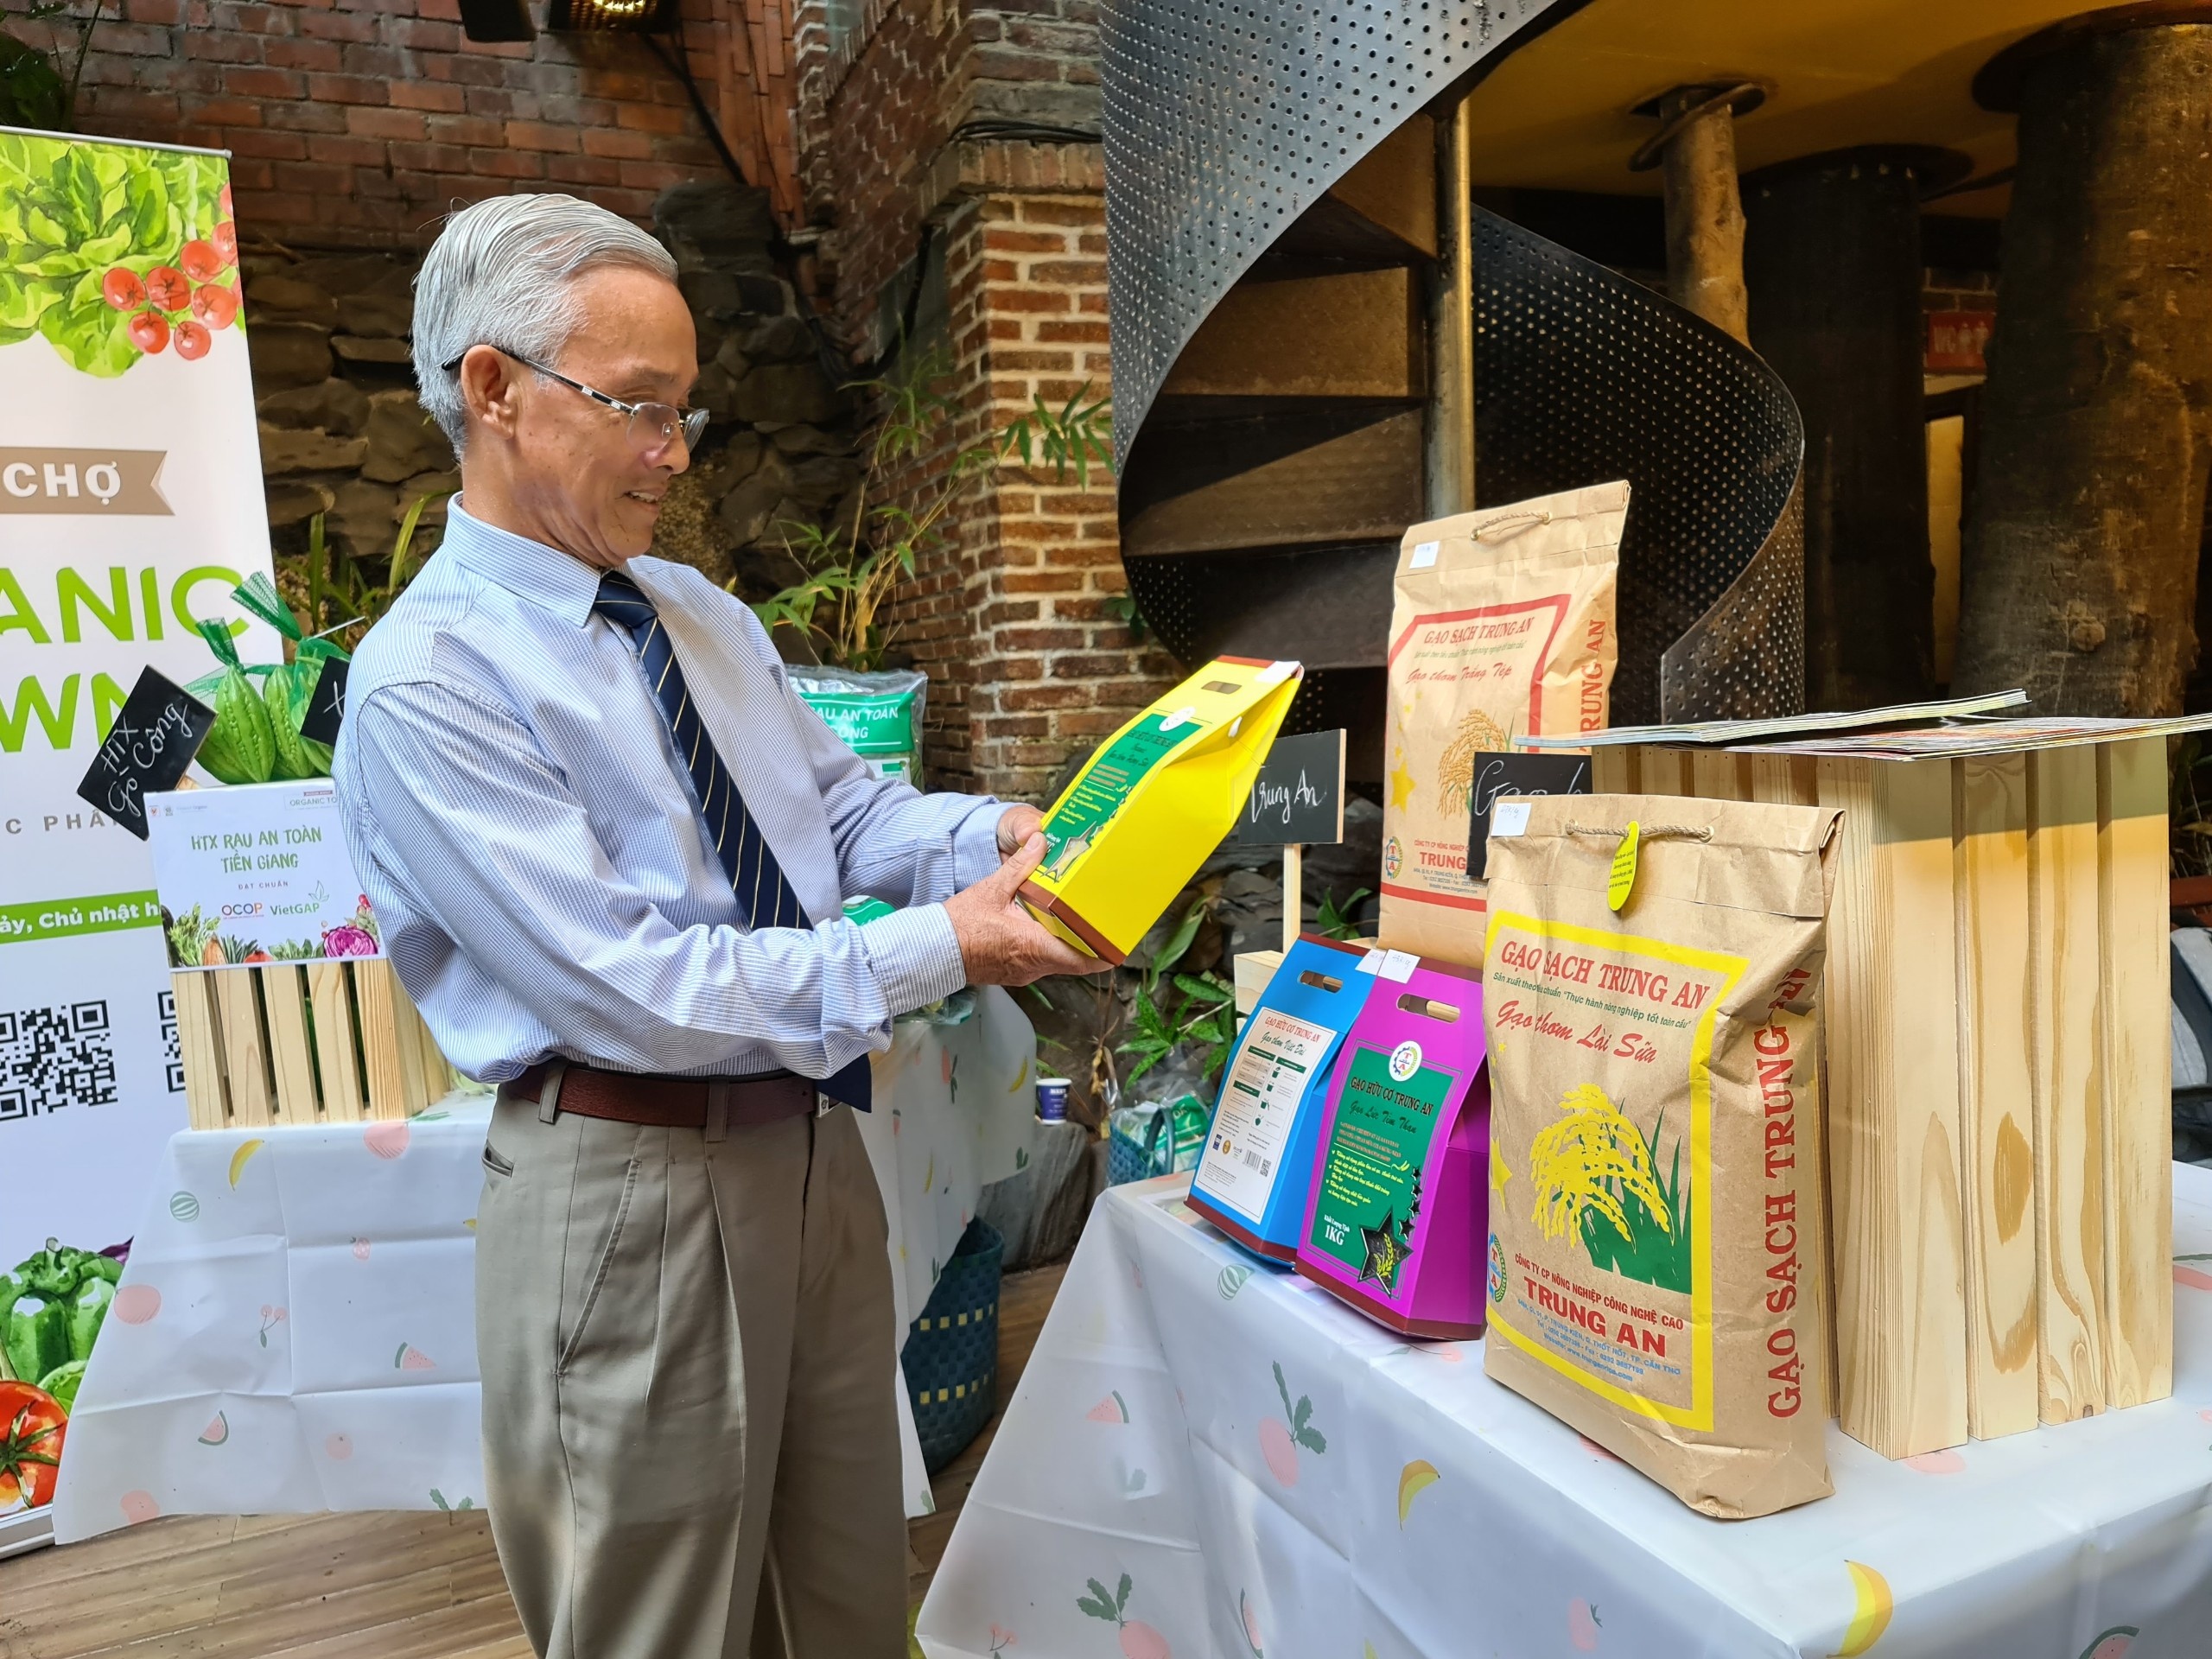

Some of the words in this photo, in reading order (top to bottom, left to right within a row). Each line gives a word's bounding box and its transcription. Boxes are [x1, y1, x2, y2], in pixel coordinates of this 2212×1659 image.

[3, 461, 122, 505] CHỢ
[1424, 630, 1449, 646] GẠO
[1450, 626, 1478, 645] SẠCH
[1478, 620, 1517, 639] TRUNG
[1516, 616, 1535, 633] AN
[1586, 619, 1606, 654] AN
[132, 702, 194, 770] Công
[840, 709, 861, 721] AN
[99, 715, 138, 772] HTX
[191, 835, 218, 851] HTX
[223, 833, 252, 849] RAU
[259, 830, 278, 846] AN
[283, 824, 322, 844] TOÀN
[1419, 851, 1466, 870] TRUNG
[38, 907, 84, 928] Chủ
[89, 904, 140, 924] nhật
[221, 903, 264, 916] OCOP
[270, 902, 321, 916] VietGAP
[1501, 940, 1543, 973] GẠO
[1542, 950, 1596, 984] SẠCH
[1597, 963, 1669, 1003] TRUNG
[1671, 981, 1711, 1010] AN
[1493, 971, 1505, 982] Sản
[1506, 976, 1522, 987] xuất
[1522, 980, 1538, 991] theo
[1585, 996, 1603, 1009] hành
[1617, 1006, 1644, 1020] nghiệp
[1647, 1012, 1659, 1024] tốt
[1660, 1016, 1675, 1027] toàn
[1495, 1000, 1533, 1030] Gạo
[1535, 1011, 1573, 1039] thơm
[1576, 1023, 1612, 1052] Lài
[1612, 1033, 1657, 1064] Sữa
[1351, 1077, 1366, 1092] GẠO
[1366, 1082, 1382, 1097] HỮU
[1382, 1088, 1395, 1101] CƠ
[1394, 1092, 1421, 1111] TRUNG
[1420, 1102, 1433, 1116] AN
[1754, 1023, 1796, 1179] TRUNG
[1325, 1224, 1344, 1246] 1KG
[1765, 1189, 1802, 1312] SẠCH
[1515, 1252, 1530, 1270] CÔNG
[1530, 1262, 1540, 1274] TY
[1541, 1268, 1550, 1280] CP
[1551, 1272, 1571, 1291] NÔNG
[1572, 1282, 1602, 1304] NGHIỆP
[1603, 1295, 1628, 1315] CÔNG
[1630, 1306, 1657, 1325] NGHỆ
[1661, 1314, 1684, 1331] CAO
[1523, 1275, 1606, 1338] TRUNG
[1616, 1322, 1666, 1358] AN
[1768, 1327, 1802, 1419] GẠO
